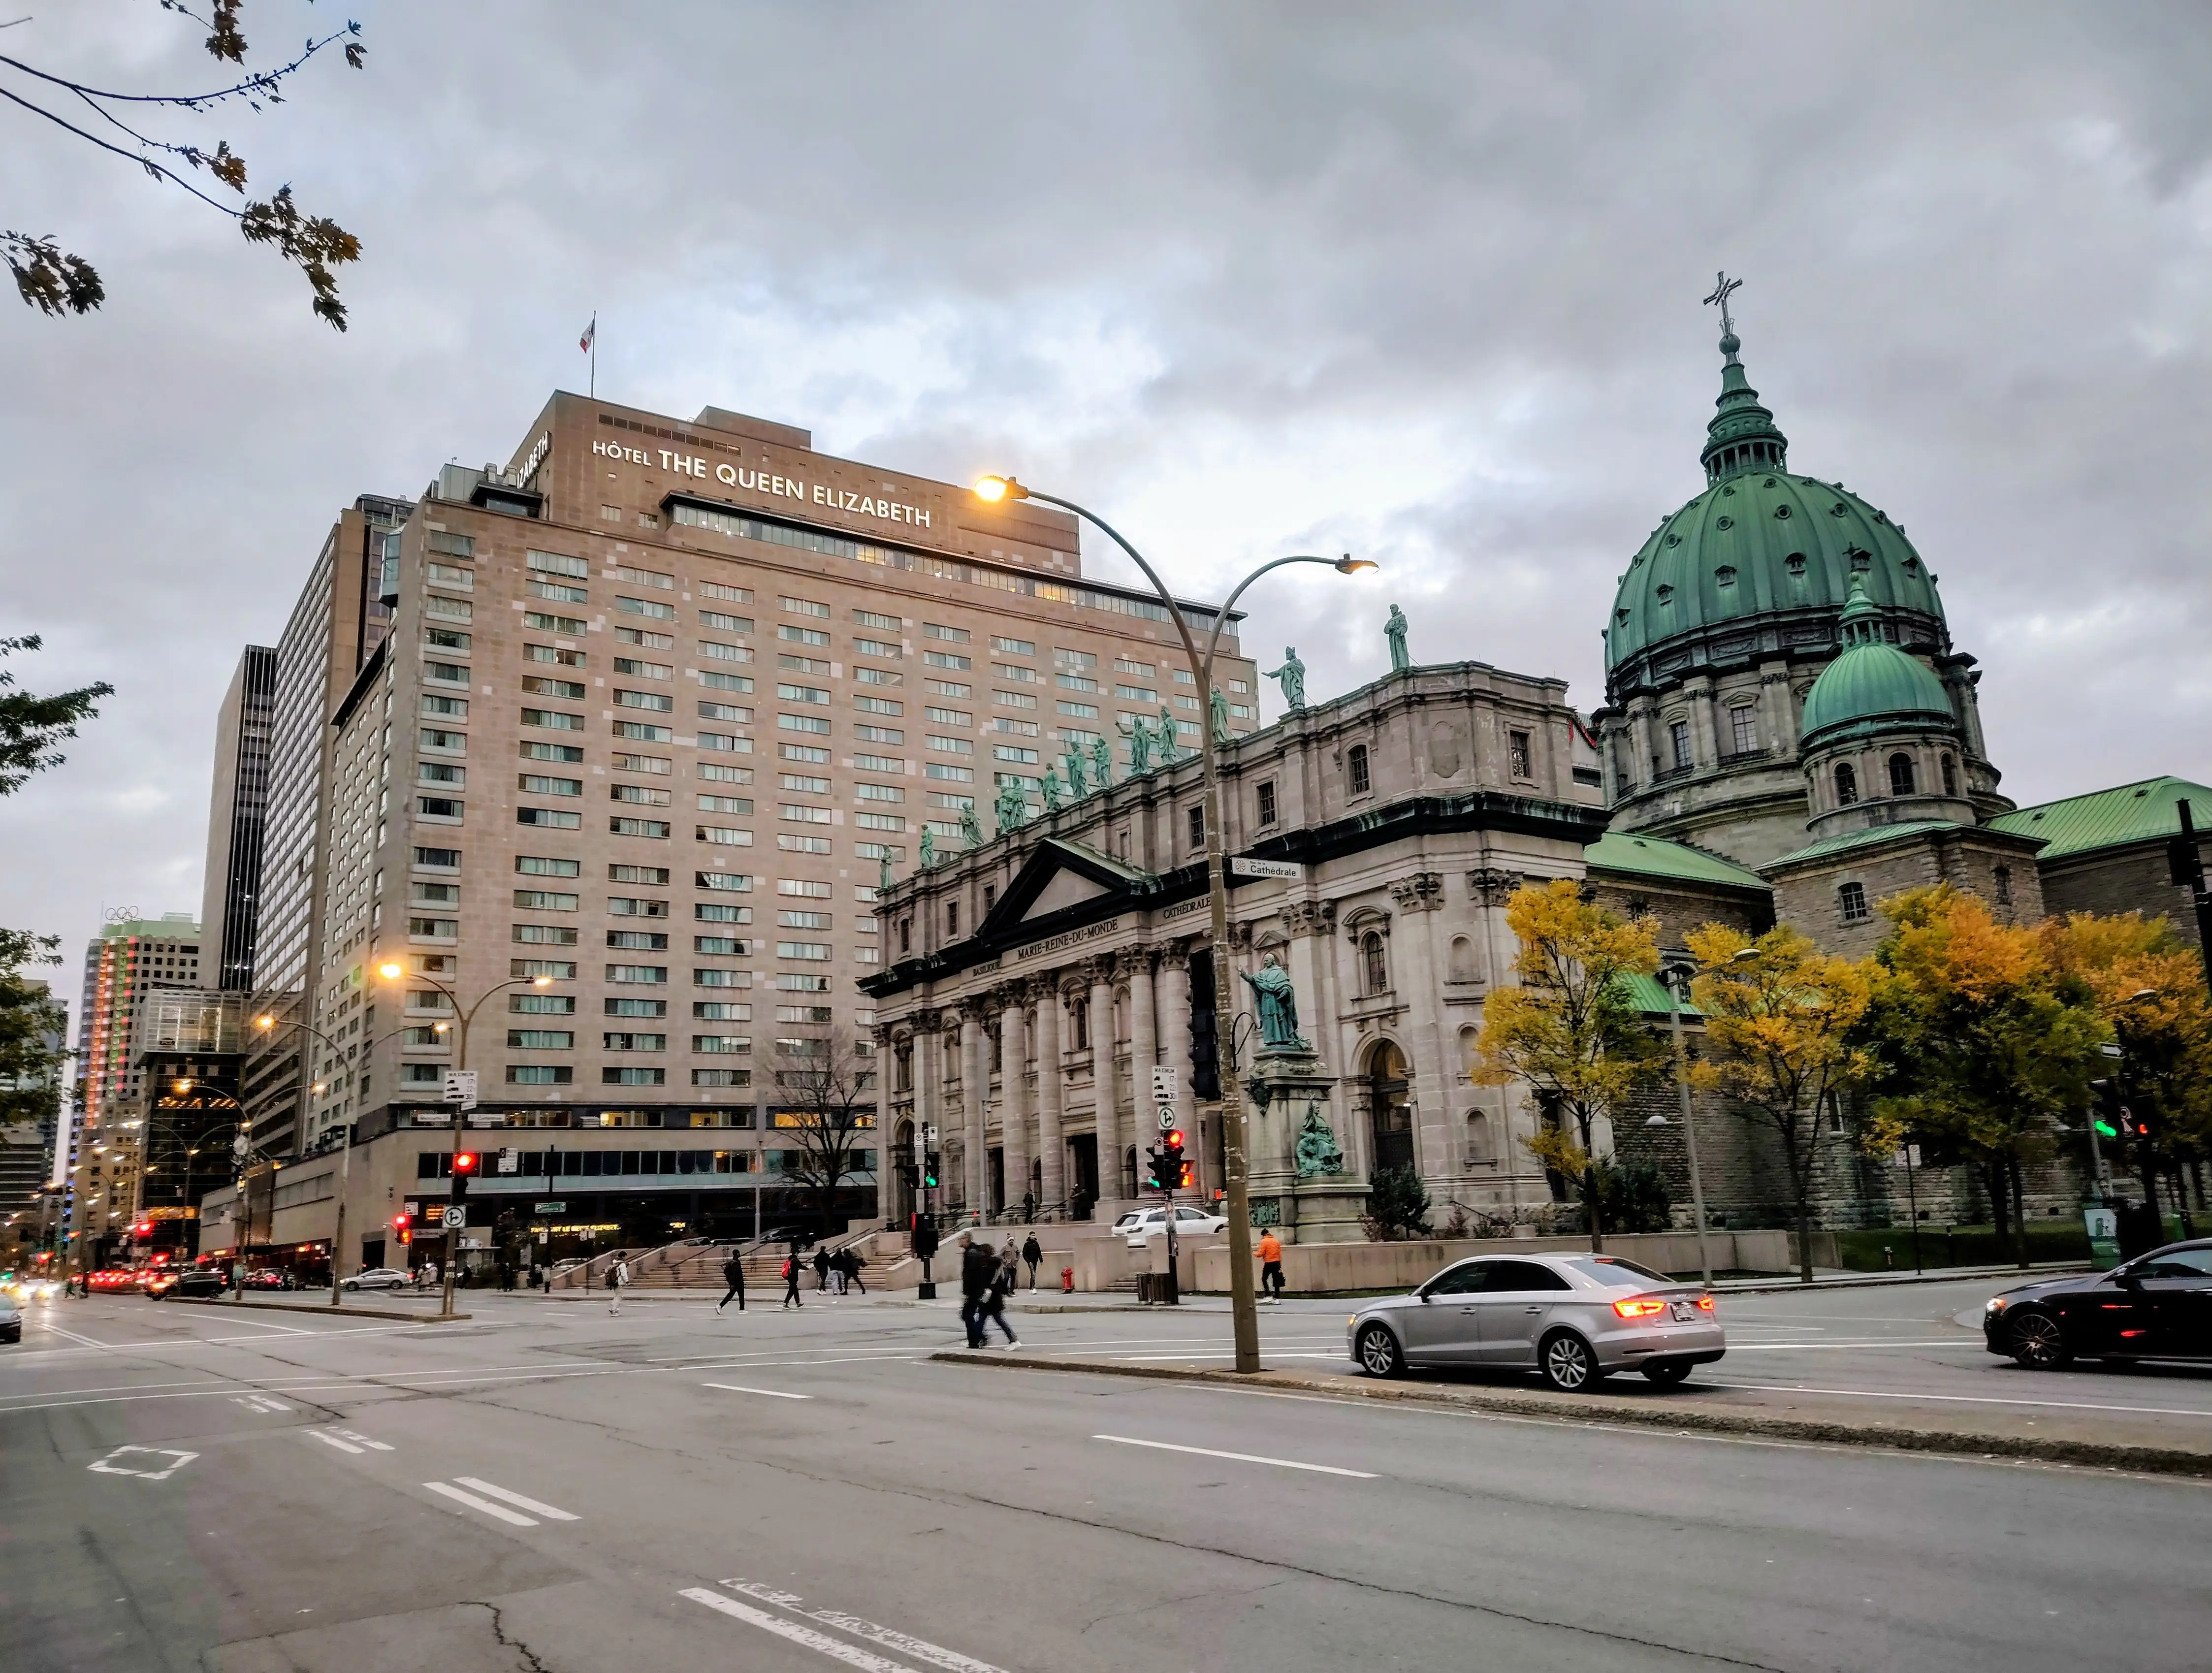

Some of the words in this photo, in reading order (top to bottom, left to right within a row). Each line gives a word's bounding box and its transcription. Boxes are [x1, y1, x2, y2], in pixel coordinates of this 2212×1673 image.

[517, 430, 551, 489] IZABETH
[592, 439, 651, 467] HÔTEL
[658, 449, 706, 478] THE
[716, 463, 803, 501] QUEEN
[813, 484, 930, 528] ELIZABETH
[1250, 865, 1296, 876] Cathédrale
[973, 961, 1000, 977] BASILIQUE
[1018, 918, 1118, 960] MARIE-REINE-DU-MONDE
[1163, 897, 1212, 919] CATHÉDRALE
